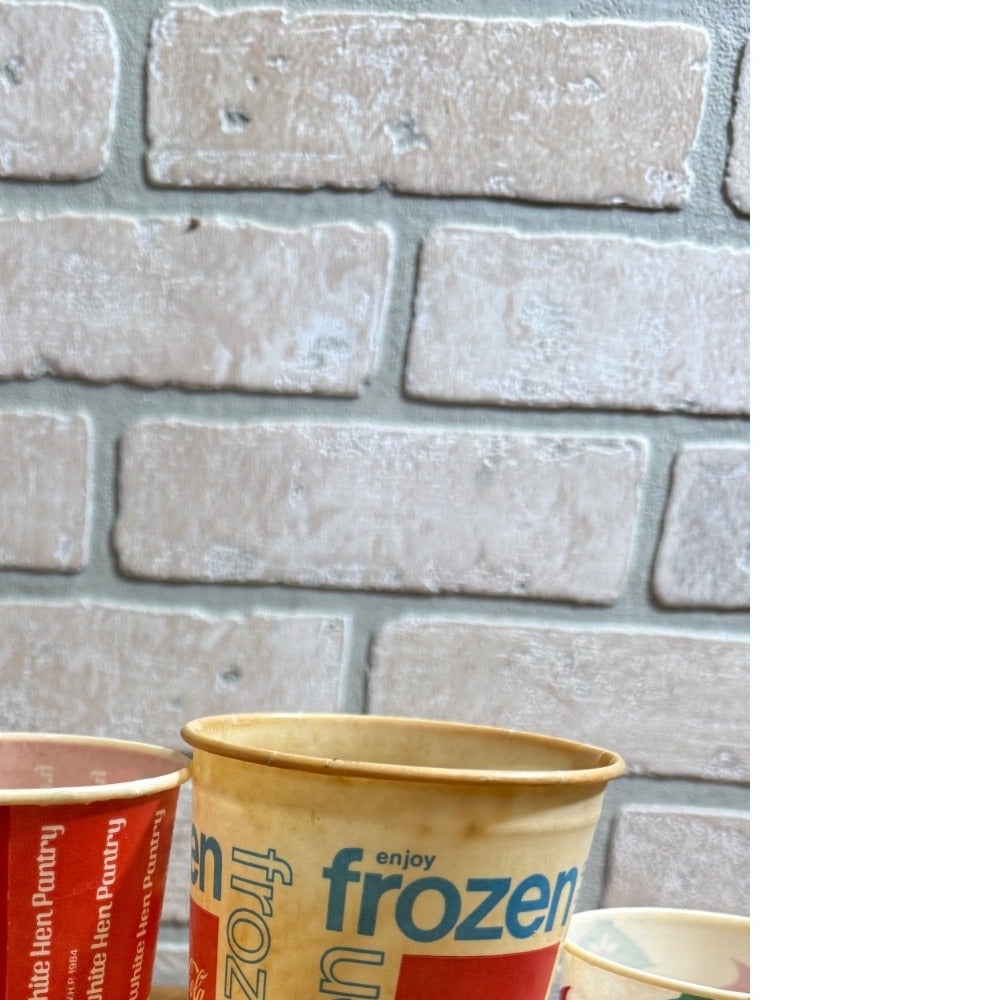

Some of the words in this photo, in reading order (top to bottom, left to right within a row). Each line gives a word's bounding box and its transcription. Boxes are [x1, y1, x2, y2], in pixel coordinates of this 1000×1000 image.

[32, 824, 65, 907] Pantry
[96, 817, 127, 901] Pantry
[143, 808, 165, 891] Pantry
[376, 849, 436, 870] enjoy
[136, 891, 153, 939] Hen
[322, 847, 579, 943] frozen
[30, 909, 54, 957] Hen
[91, 901, 113, 950] Hen
[69, 949, 78, 973] 1984
